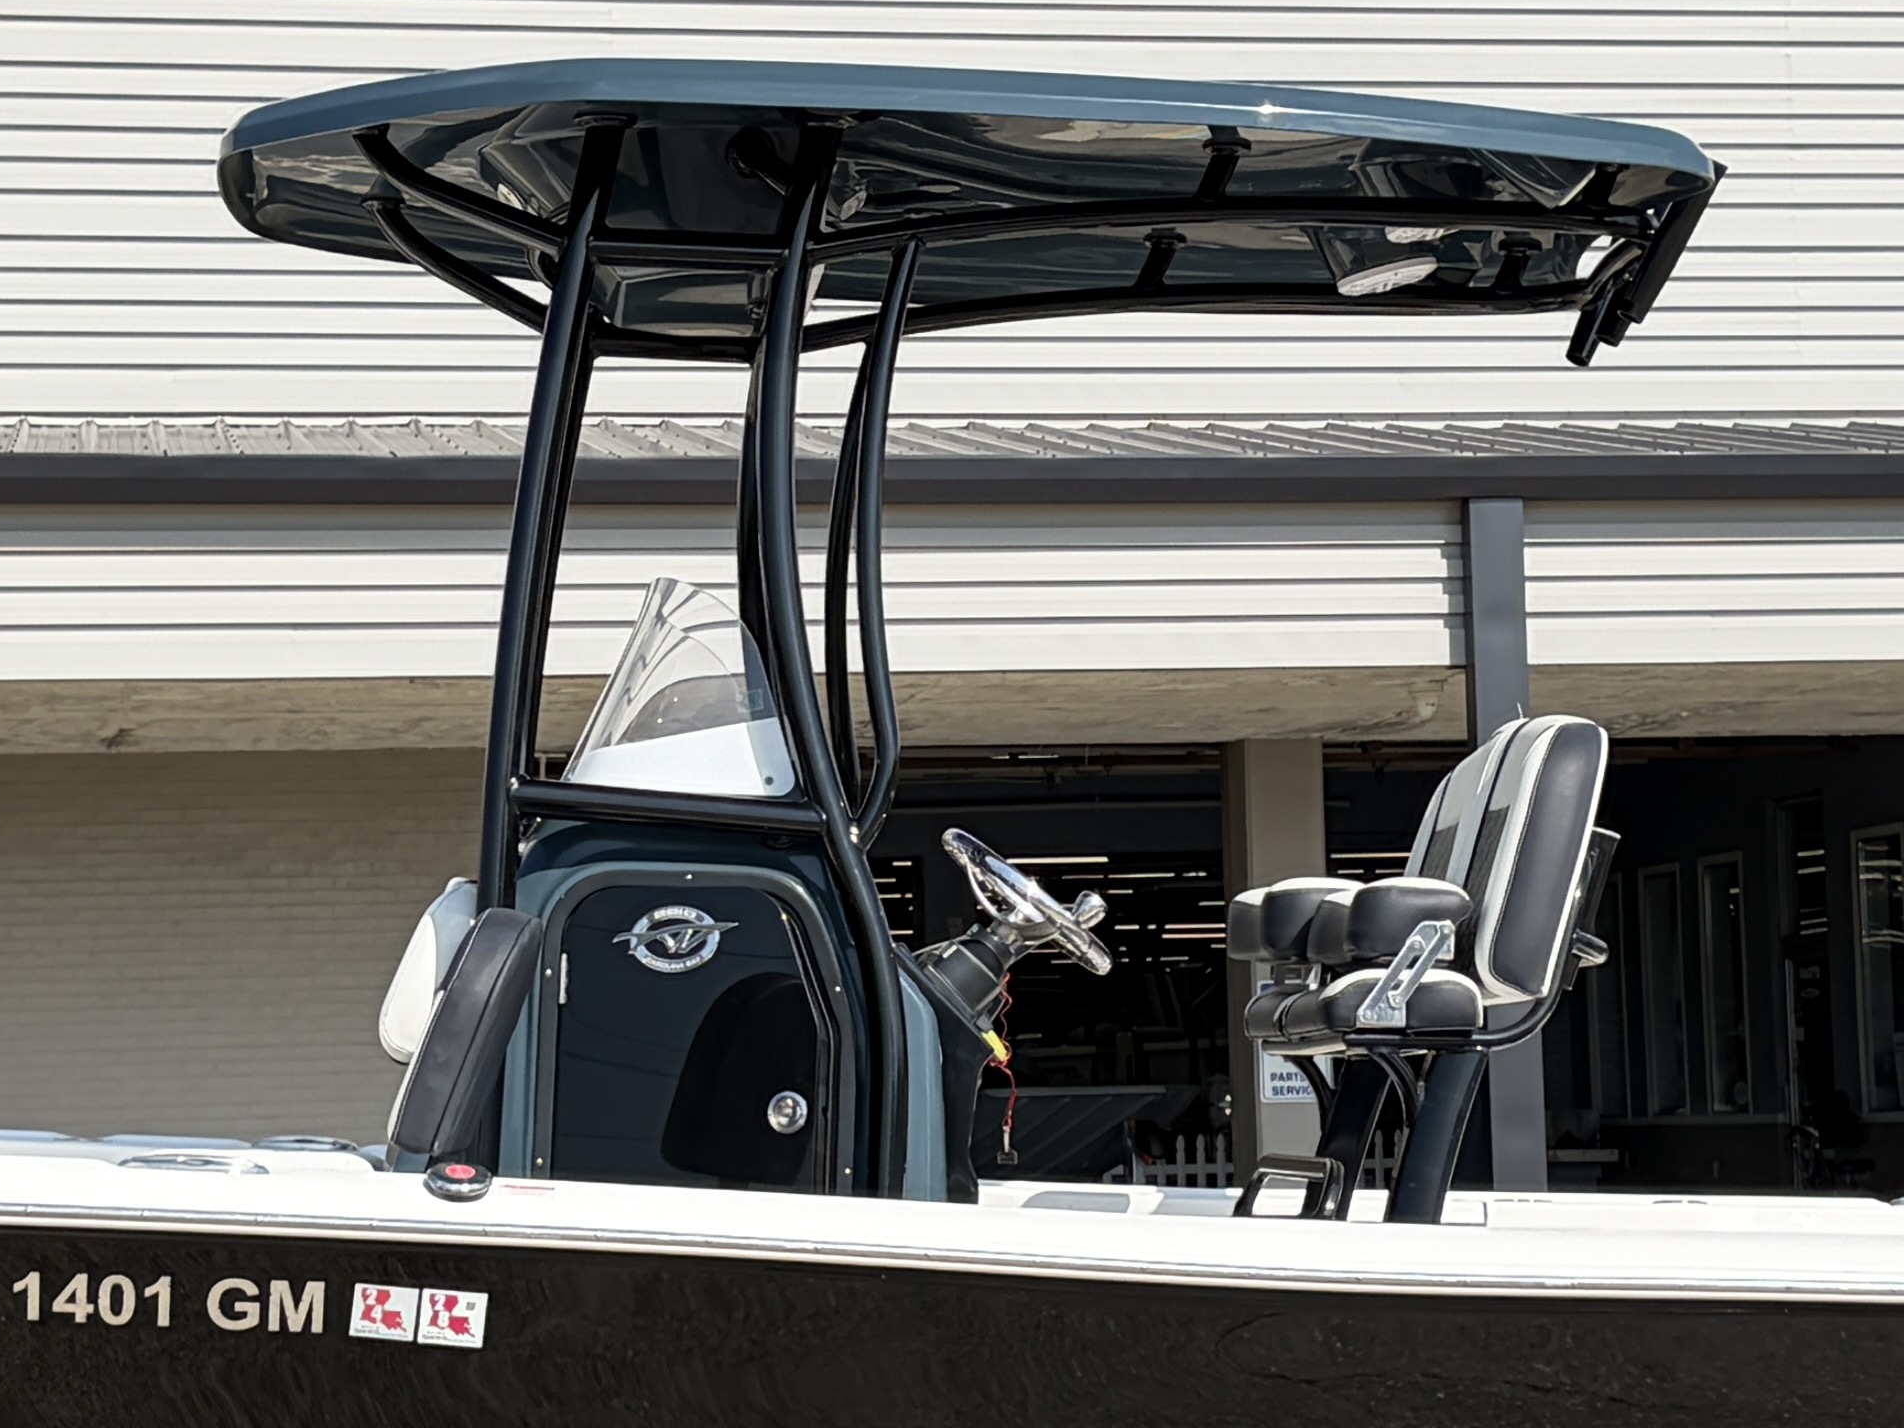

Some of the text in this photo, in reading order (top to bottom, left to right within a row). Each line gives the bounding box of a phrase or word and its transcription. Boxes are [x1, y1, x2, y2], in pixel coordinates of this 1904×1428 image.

[1272, 1086, 1314, 1096] SERVIC
[12, 1271, 172, 1327] 1401
[206, 1277, 327, 1334] GM
